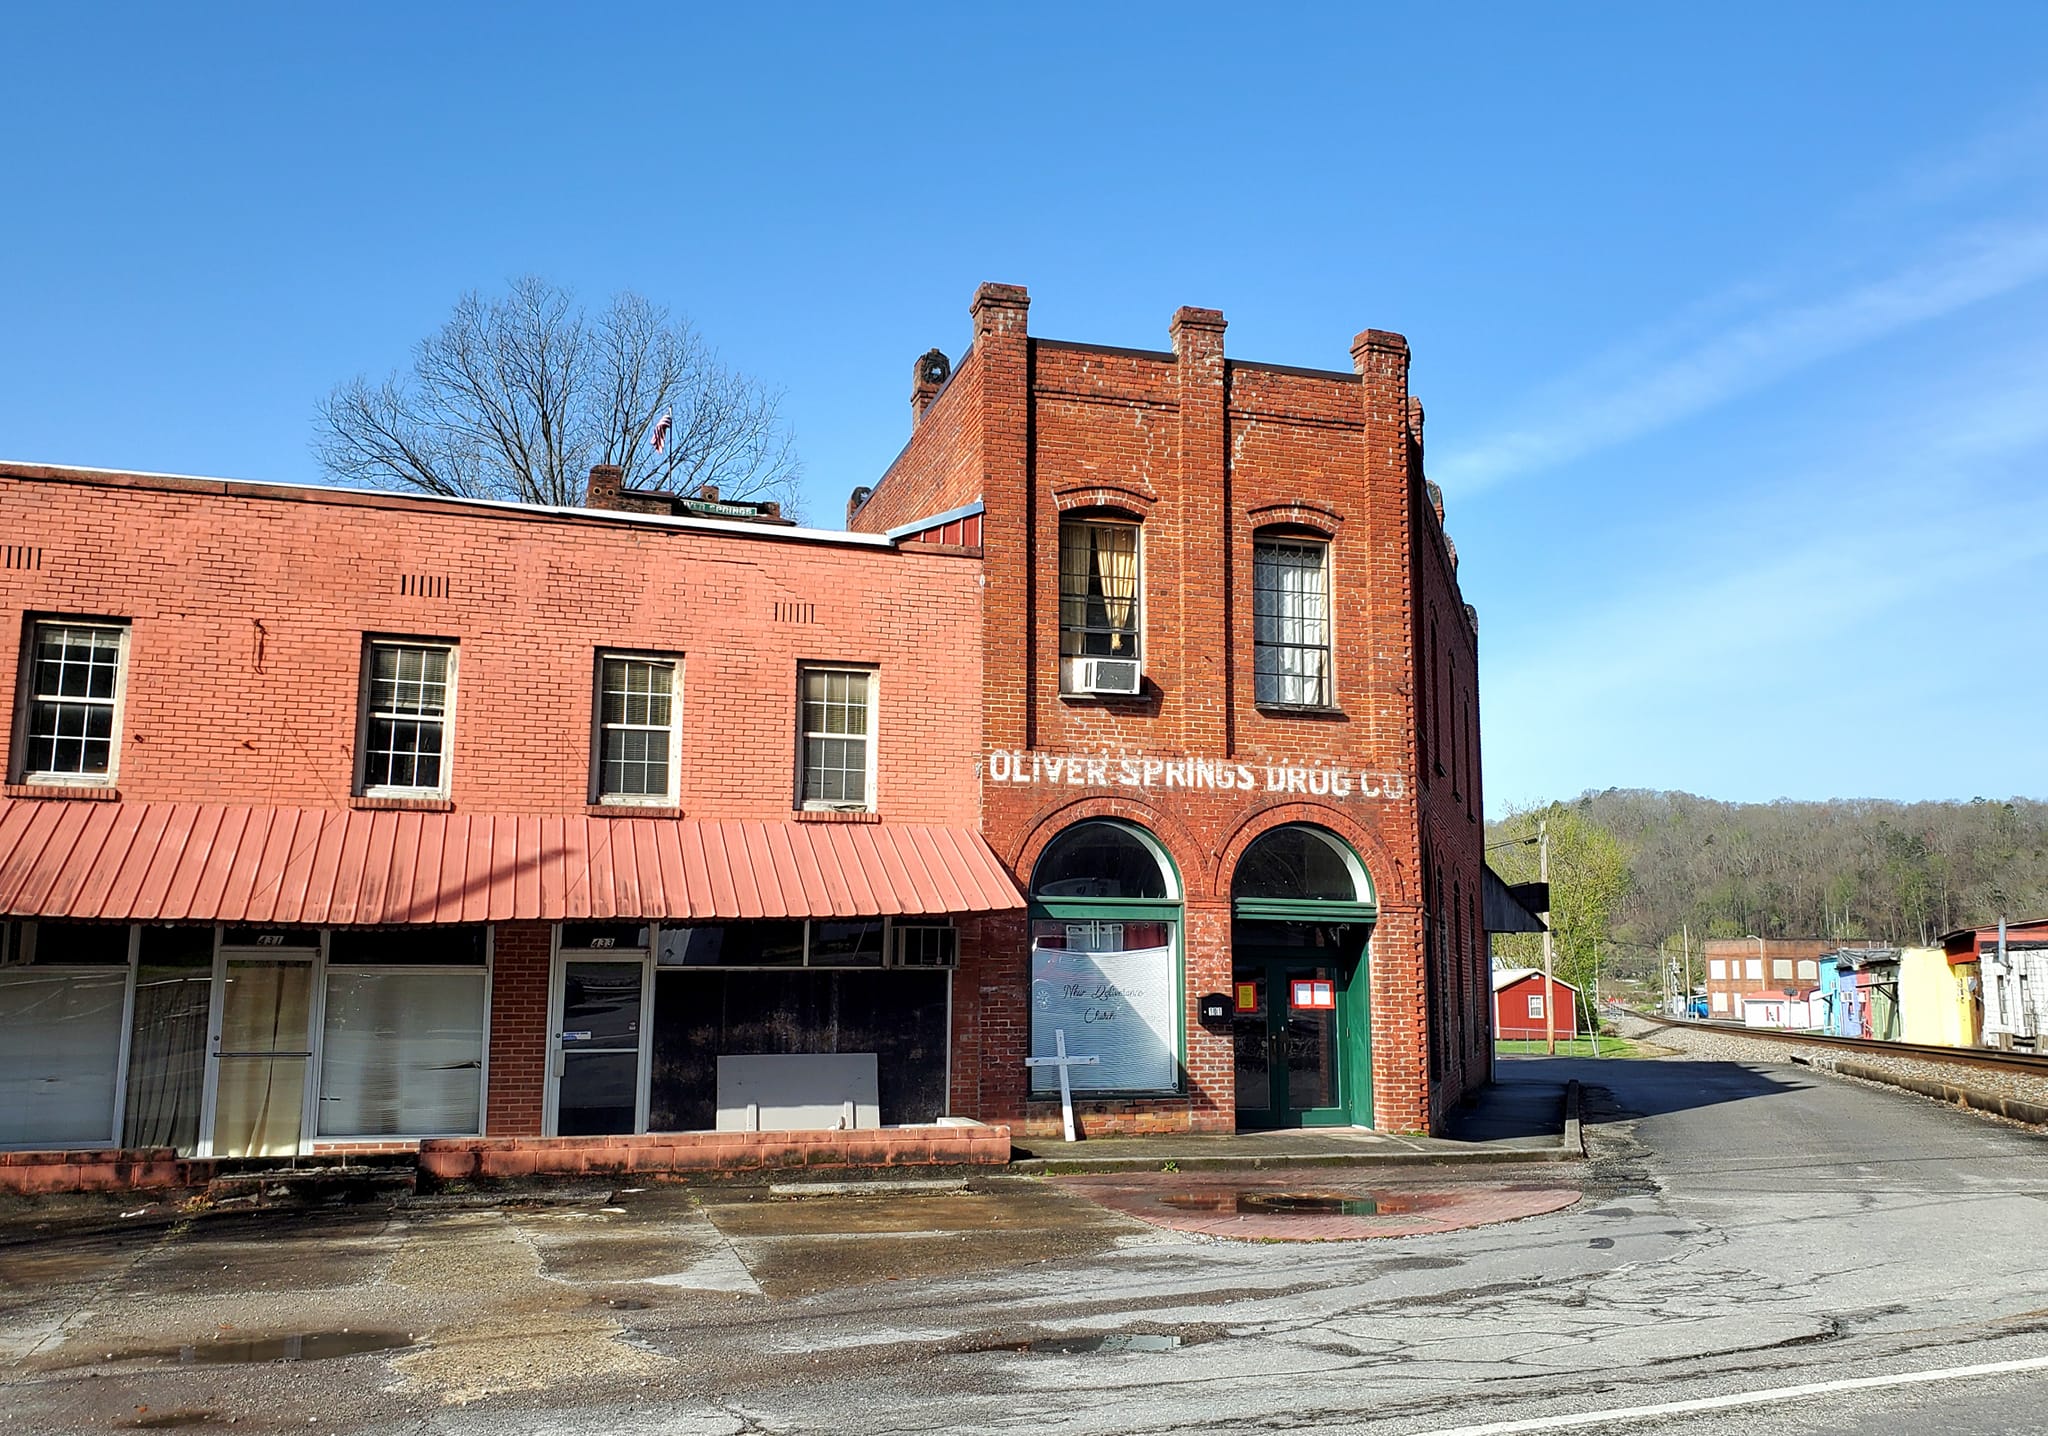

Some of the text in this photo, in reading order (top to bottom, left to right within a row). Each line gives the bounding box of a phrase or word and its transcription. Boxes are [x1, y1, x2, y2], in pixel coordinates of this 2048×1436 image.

[989, 749, 1107, 786] OLIVER
[1117, 757, 1255, 790] SPRINGS
[1266, 764, 1351, 797] DRUG
[257, 935, 285, 946] 431
[591, 938, 615, 949] 433
